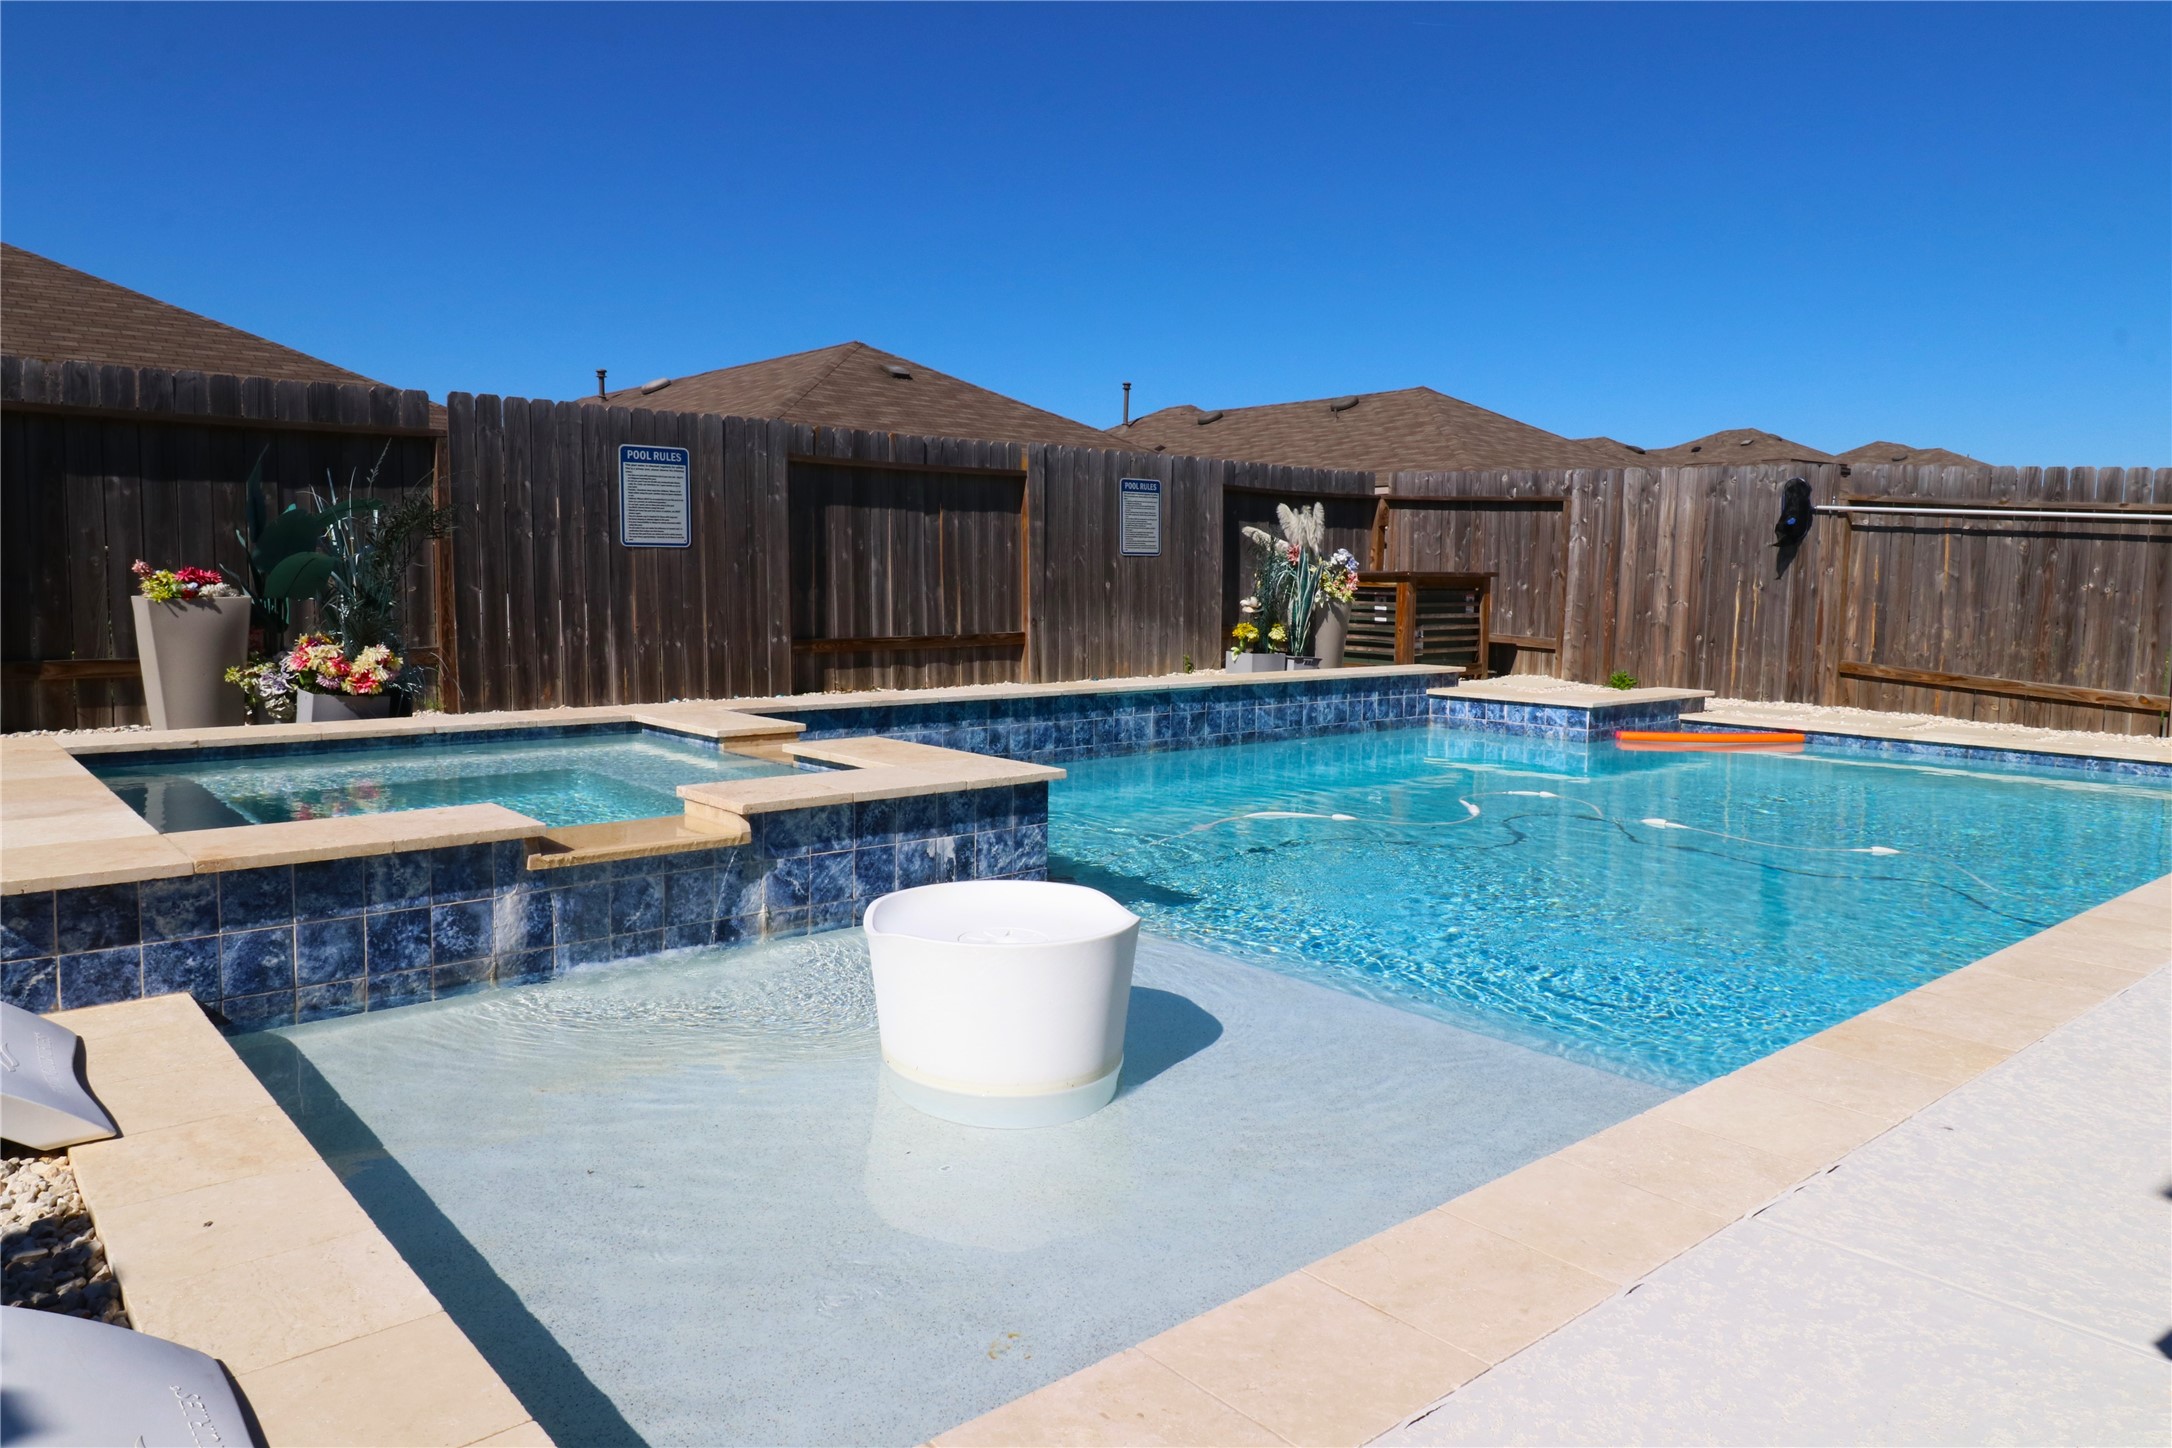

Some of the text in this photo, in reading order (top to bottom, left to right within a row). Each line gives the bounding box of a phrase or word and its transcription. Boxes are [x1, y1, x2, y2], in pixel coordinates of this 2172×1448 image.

[627, 450, 682, 462] POOL RULES
[1124, 481, 1157, 491] POOL RULES
